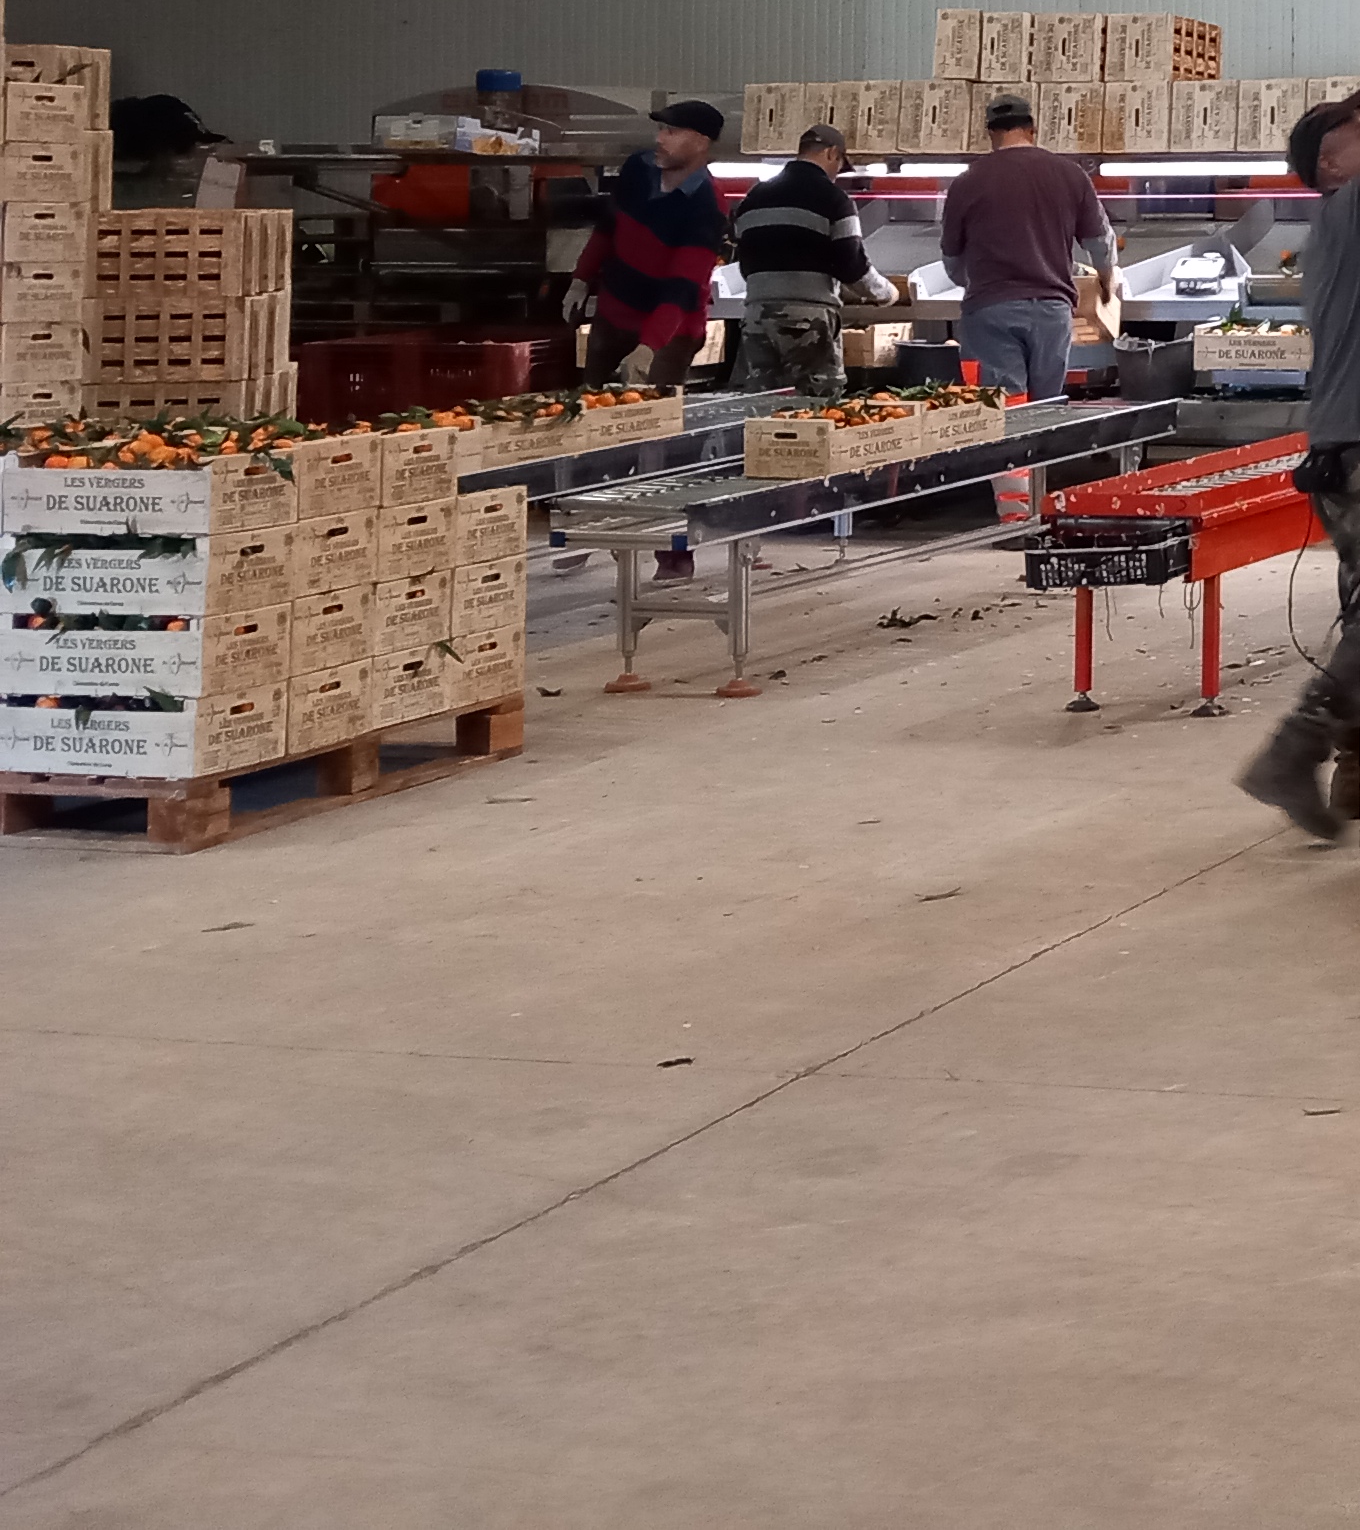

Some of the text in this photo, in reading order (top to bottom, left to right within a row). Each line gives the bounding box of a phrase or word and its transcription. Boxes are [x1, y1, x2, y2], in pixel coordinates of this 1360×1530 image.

[1218, 350, 1232, 359] DE
[64, 477, 145, 488] LES VERGERS
[46, 495, 162, 512] DE SUARONE
[85, 558, 141, 569] VERGERS
[42, 576, 159, 593] DE SUARONE
[56, 638, 136, 650] LES VERGERS
[40, 656, 154, 673] DE SUARONE
[33, 736, 147, 755] DE SUARONE
